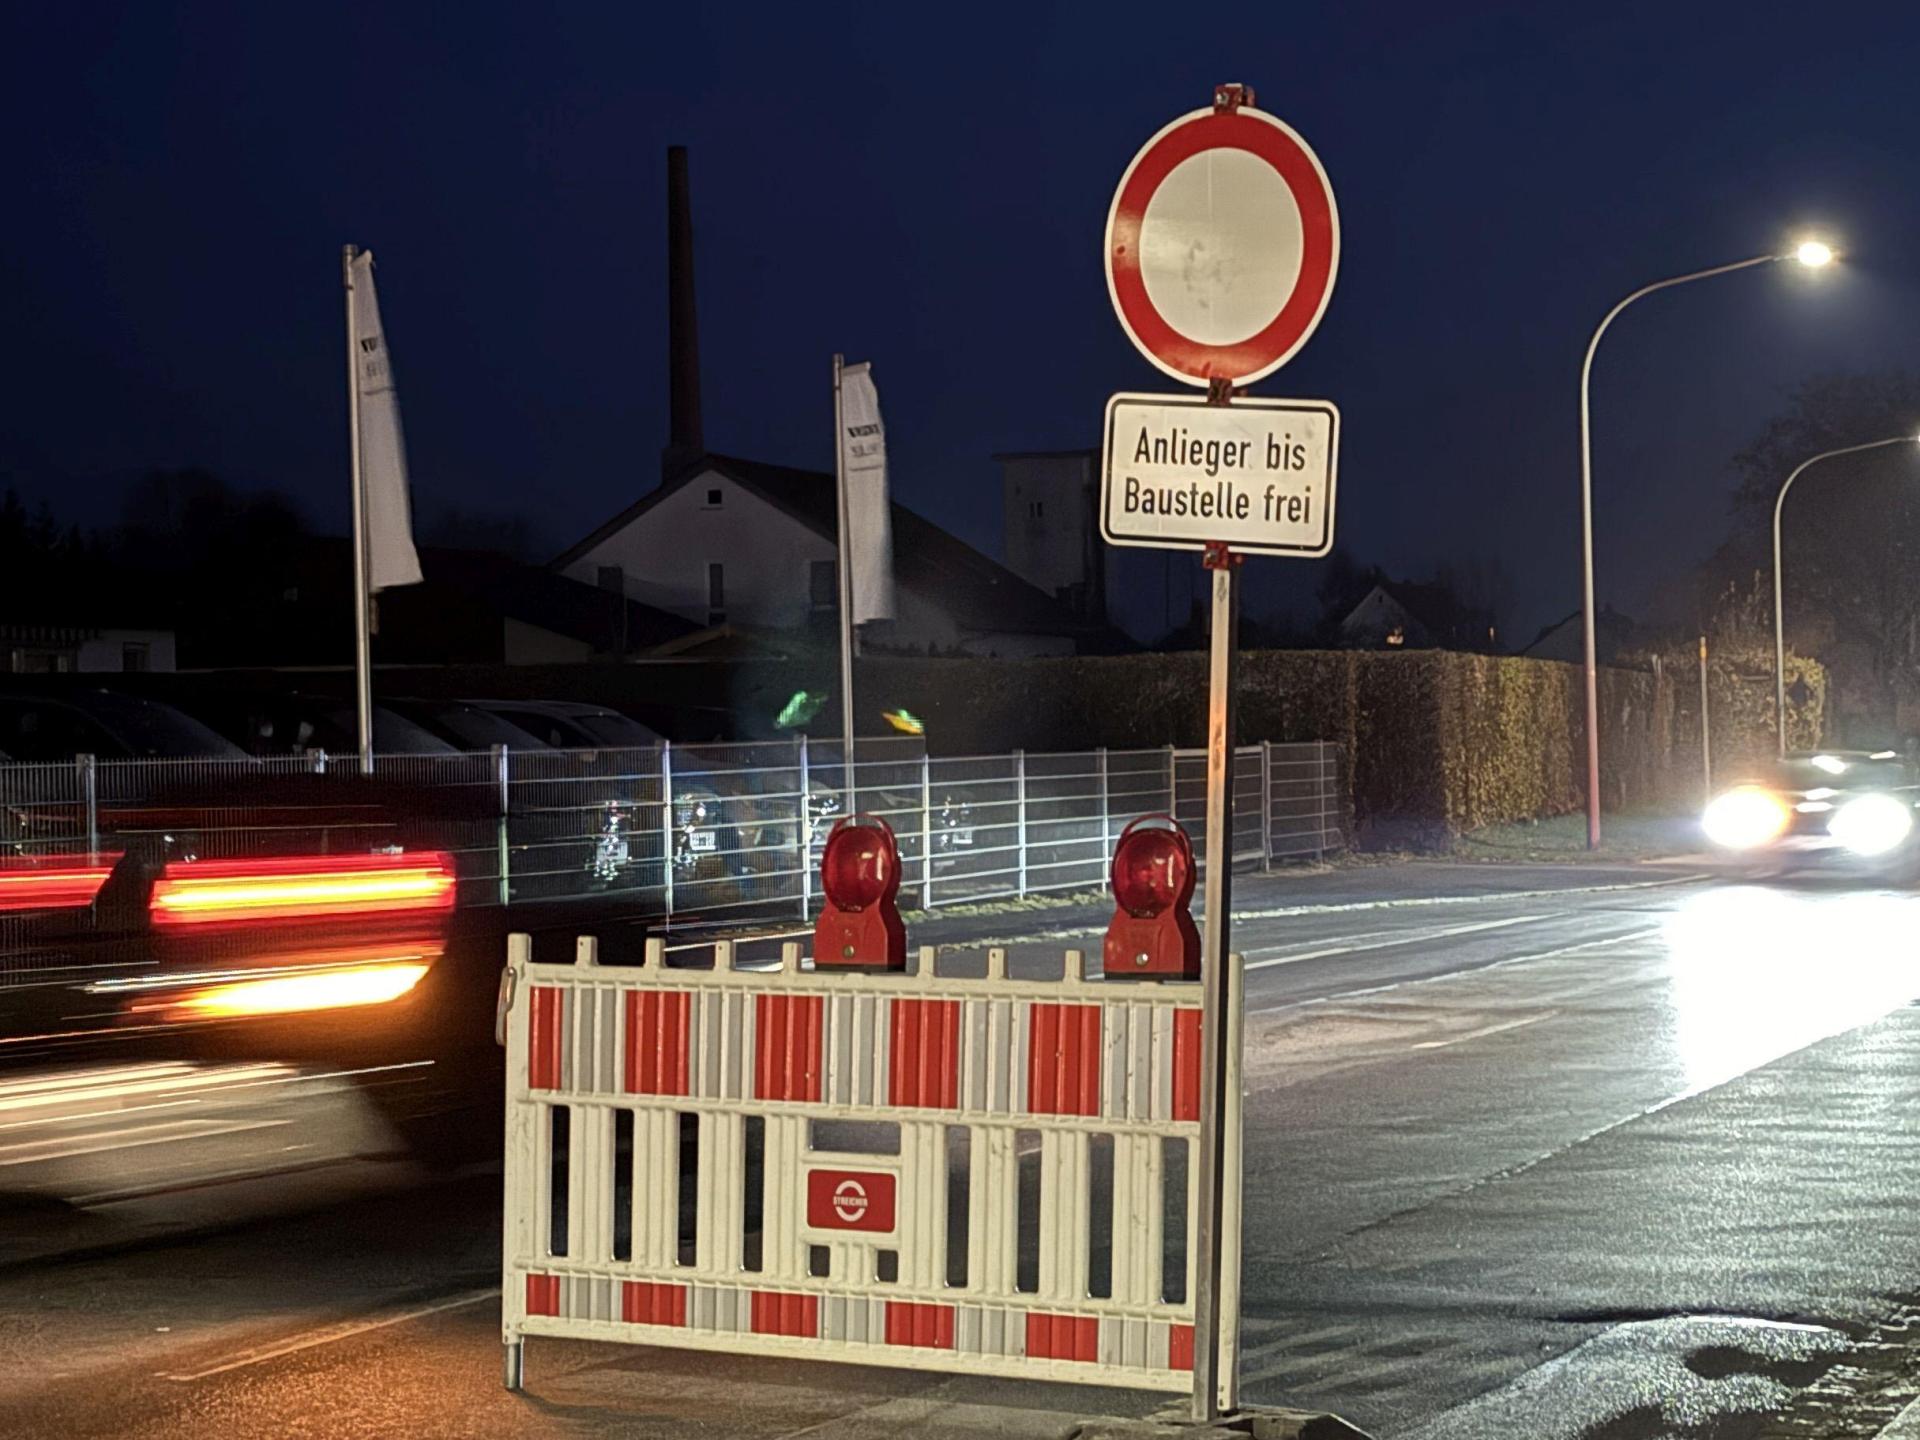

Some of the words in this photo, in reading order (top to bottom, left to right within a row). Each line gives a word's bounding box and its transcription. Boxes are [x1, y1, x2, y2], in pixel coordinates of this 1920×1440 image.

[1134, 426, 1251, 476] Anlieger
[1266, 432, 1306, 470] bis
[1125, 477, 1250, 520] Baustelle
[1264, 484, 1311, 524] frei
